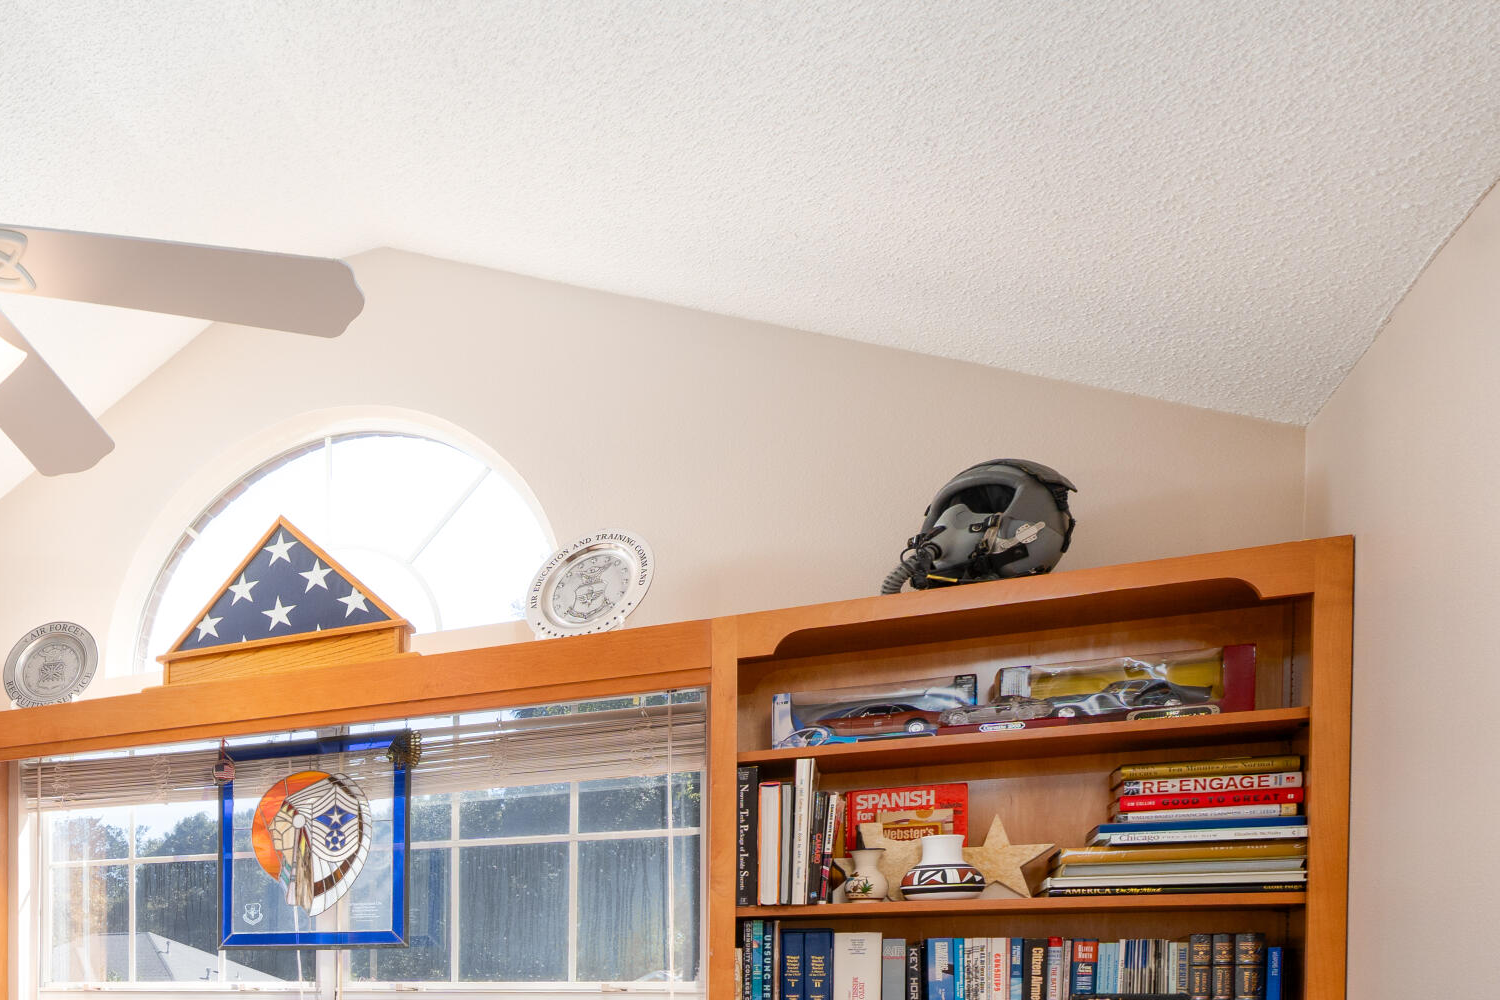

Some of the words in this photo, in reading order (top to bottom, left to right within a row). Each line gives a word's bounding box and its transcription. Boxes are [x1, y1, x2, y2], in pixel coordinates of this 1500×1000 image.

[533, 548, 569, 593] EDUCATION
[572, 537, 592, 551] AND
[595, 533, 636, 547] TRAINING
[634, 544, 648, 586] COMMAND
[29, 626, 46, 640] AIR
[49, 623, 81, 635] FORCE
[1168, 766, 1183, 774] Ten
[1243, 761, 1275, 769] Normal
[1179, 775, 1271, 791] ENGAGE
[856, 790, 935, 810] SPANISH
[1161, 798, 1200, 806] GOOD
[1208, 796, 1225, 804] TO
[1233, 793, 1281, 803] GREAT
[856, 811, 874, 821] for
[738, 824, 749, 846] Package
[1119, 833, 1160, 842] Chicago
[814, 832, 822, 864] CAMARO
[739, 853, 749, 870] Inside
[739, 870, 749, 891] Secrets
[1064, 887, 1112, 895] AMERICA
[763, 934, 771, 980] UNSUNG
[909, 948, 918, 971] KEY
[1031, 947, 1044, 975] Citizen
[1179, 948, 1187, 961] THE
[993, 953, 1001, 992] GUNSHIPS
[1178, 963, 1187, 987] BERLIN
[1049, 977, 1057, 997] BATTLE
